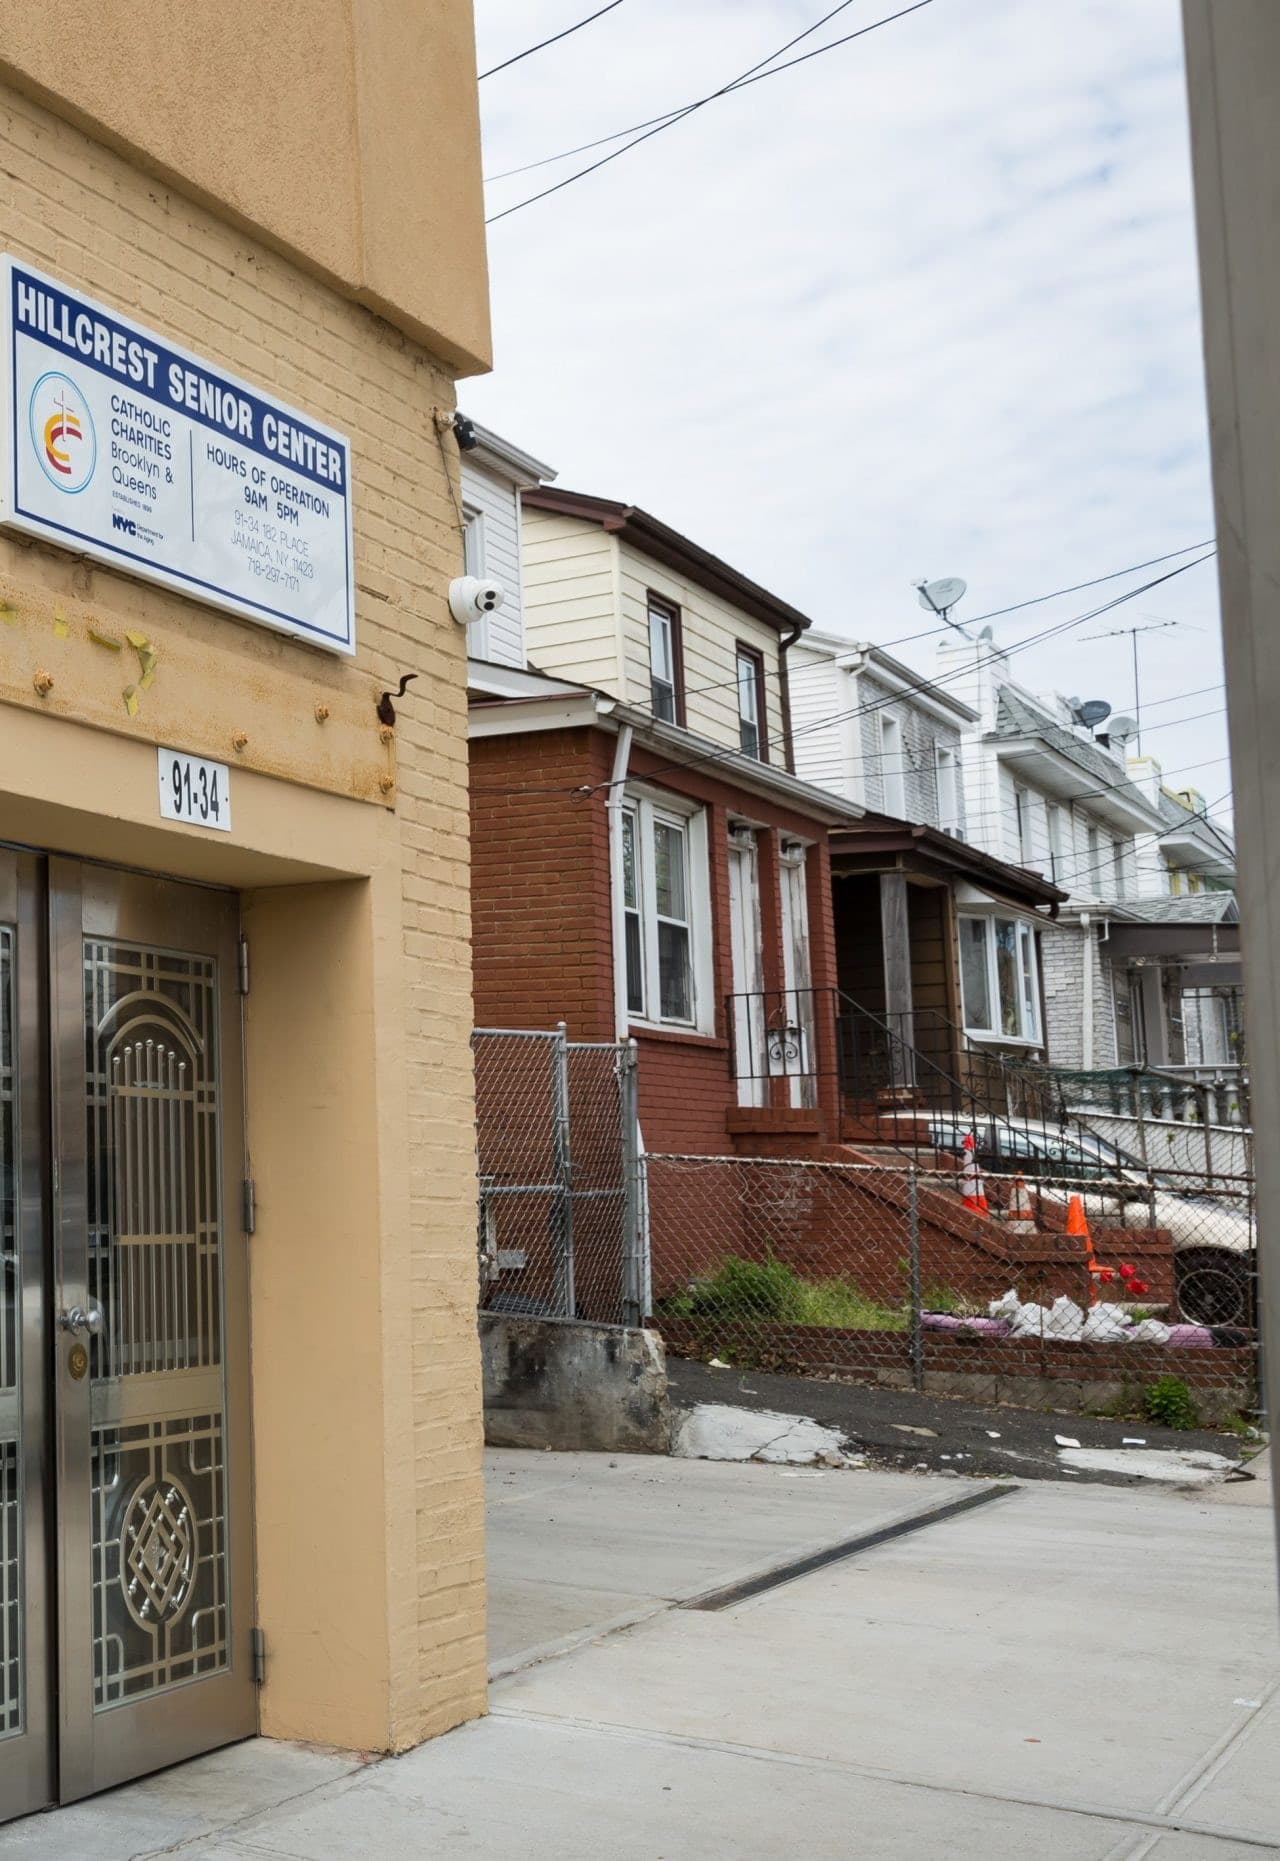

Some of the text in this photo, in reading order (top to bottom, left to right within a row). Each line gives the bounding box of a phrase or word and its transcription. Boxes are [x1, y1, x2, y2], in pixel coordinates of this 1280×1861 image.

[17, 281, 342, 486] HILLCREST SENIOR CENTER
[111, 395, 171, 437] CATHOLIC
[111, 418, 172, 460] CHARITIES
[111, 441, 174, 484] Brooklyn &
[112, 466, 157, 500] Queens
[207, 443, 330, 519] HOURS OF OPERATION
[112, 513, 136, 536] NYC
[244, 486, 299, 526] 9AM 5PM
[263, 523, 277, 543] 182
[280, 530, 310, 558] PLACE
[277, 549, 289, 567] NY
[292, 558, 314, 579] 11423
[172, 760, 219, 822] 91-34
